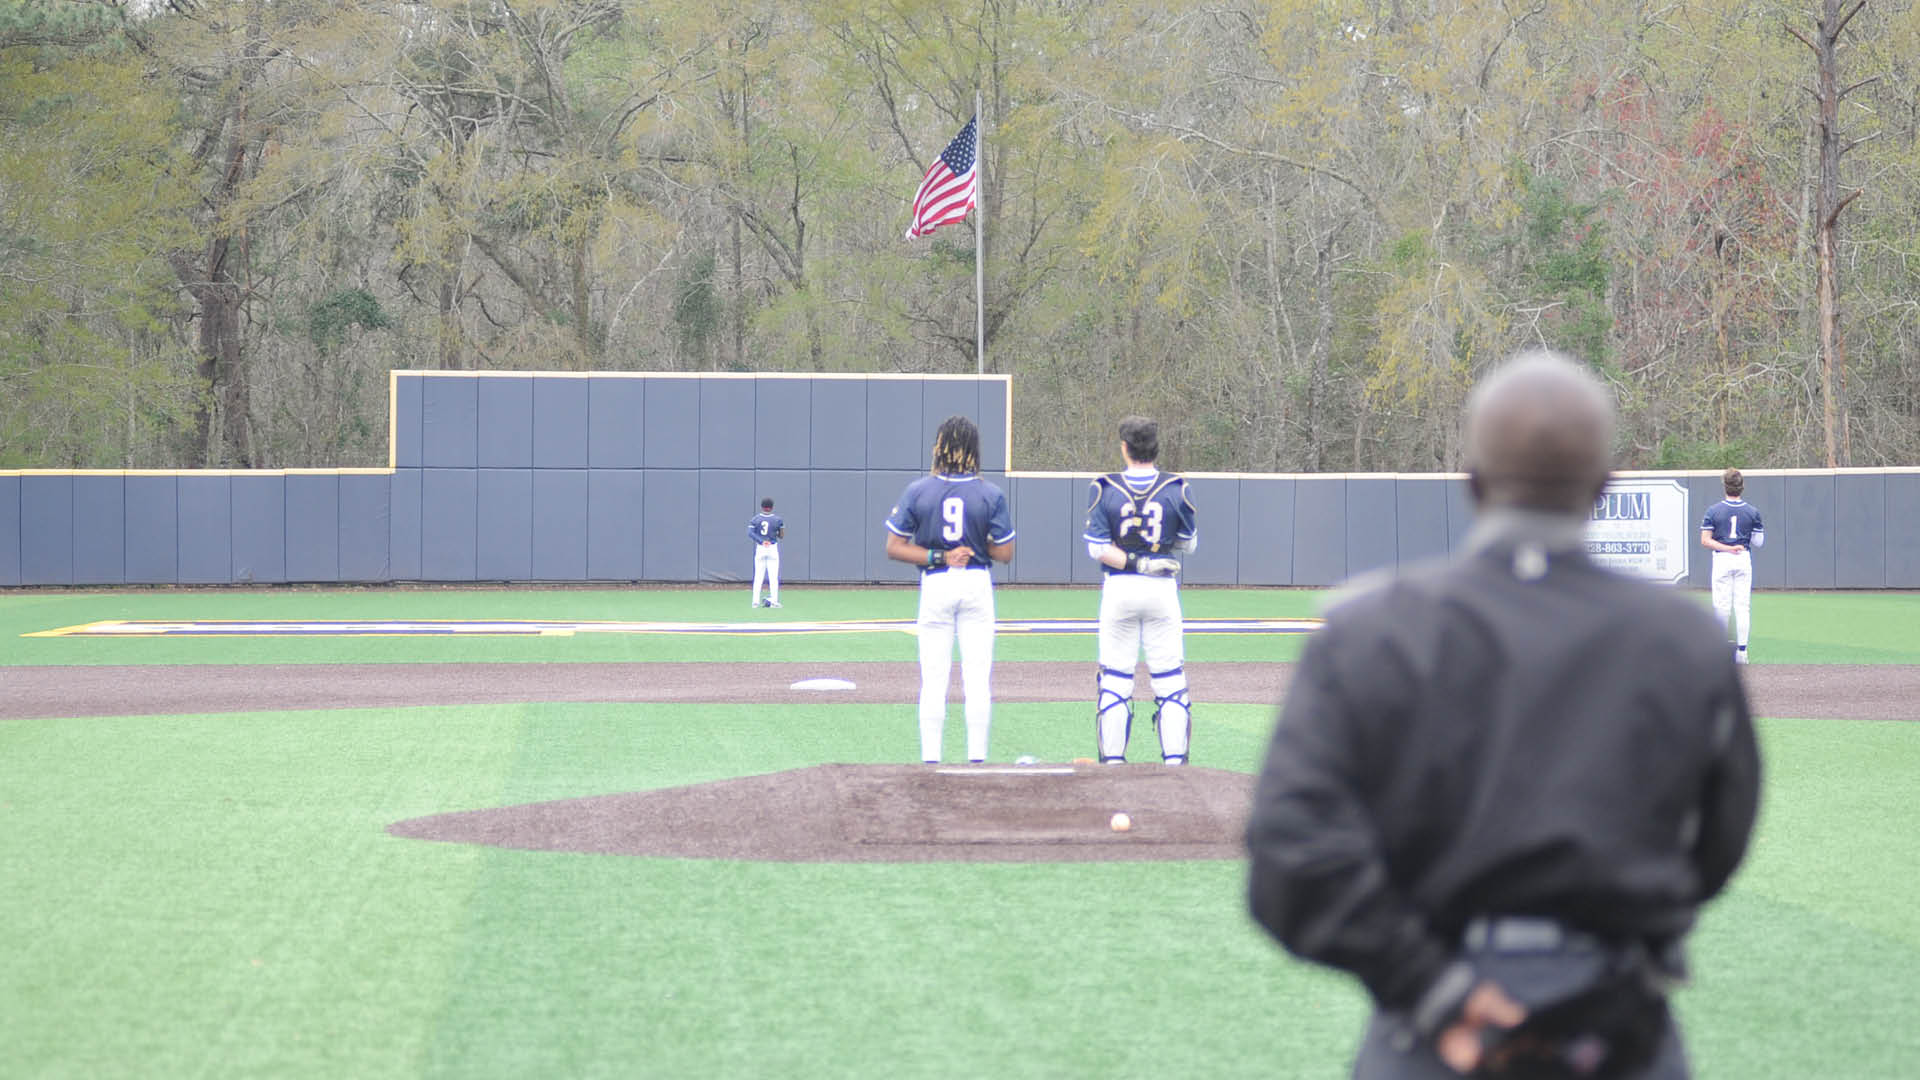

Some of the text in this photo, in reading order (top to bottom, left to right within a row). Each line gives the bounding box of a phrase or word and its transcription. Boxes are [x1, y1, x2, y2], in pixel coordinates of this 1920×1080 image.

[1592, 493, 1649, 519] PLUM
[760, 520, 769, 536] 3
[942, 497, 964, 542] 9
[1119, 501, 1163, 545] 23
[1729, 515, 1738, 539] 1
